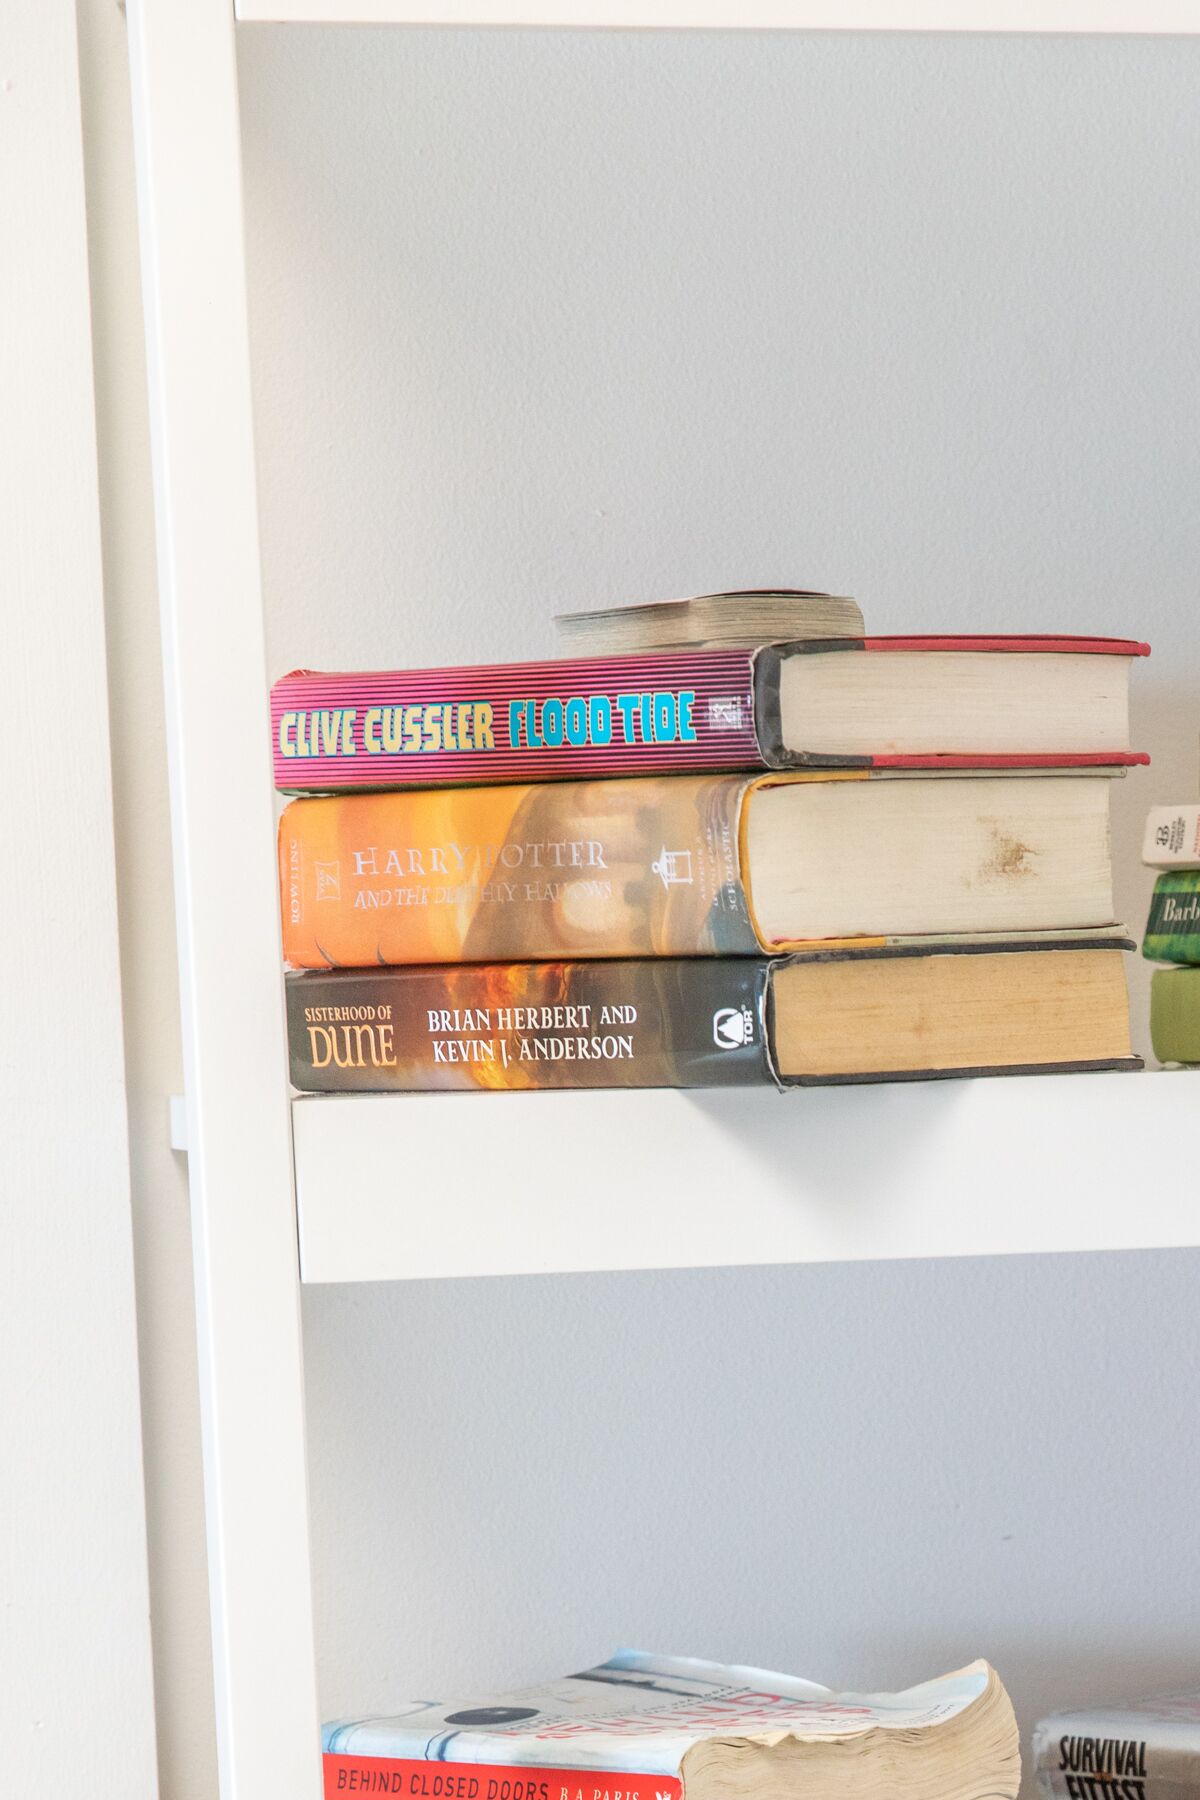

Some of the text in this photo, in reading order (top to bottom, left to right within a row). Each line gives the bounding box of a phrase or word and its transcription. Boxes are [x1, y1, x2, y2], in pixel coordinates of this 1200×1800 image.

[279, 700, 496, 758] CLIVE CUSSLER
[509, 695, 612, 748] FLOOD
[617, 691, 697, 744] TIDE
[352, 843, 470, 876] HARRY
[354, 889, 392, 910] AND
[396, 884, 430, 907] THE
[435, 882, 518, 905] DEHLY
[305, 1005, 392, 1022] SISTERHOOD OF
[427, 1005, 637, 1032] BRIAN HERBERT AND
[743, 1010, 753, 1045] TOR
[307, 1024, 397, 1068] DUNE
[432, 1036, 634, 1069] KEVIN J. ANDERSON
[1059, 1735, 1148, 1778] SURVIVAL
[337, 1768, 402, 1793] BEHIND
[410, 1774, 479, 1799] CLOSED
